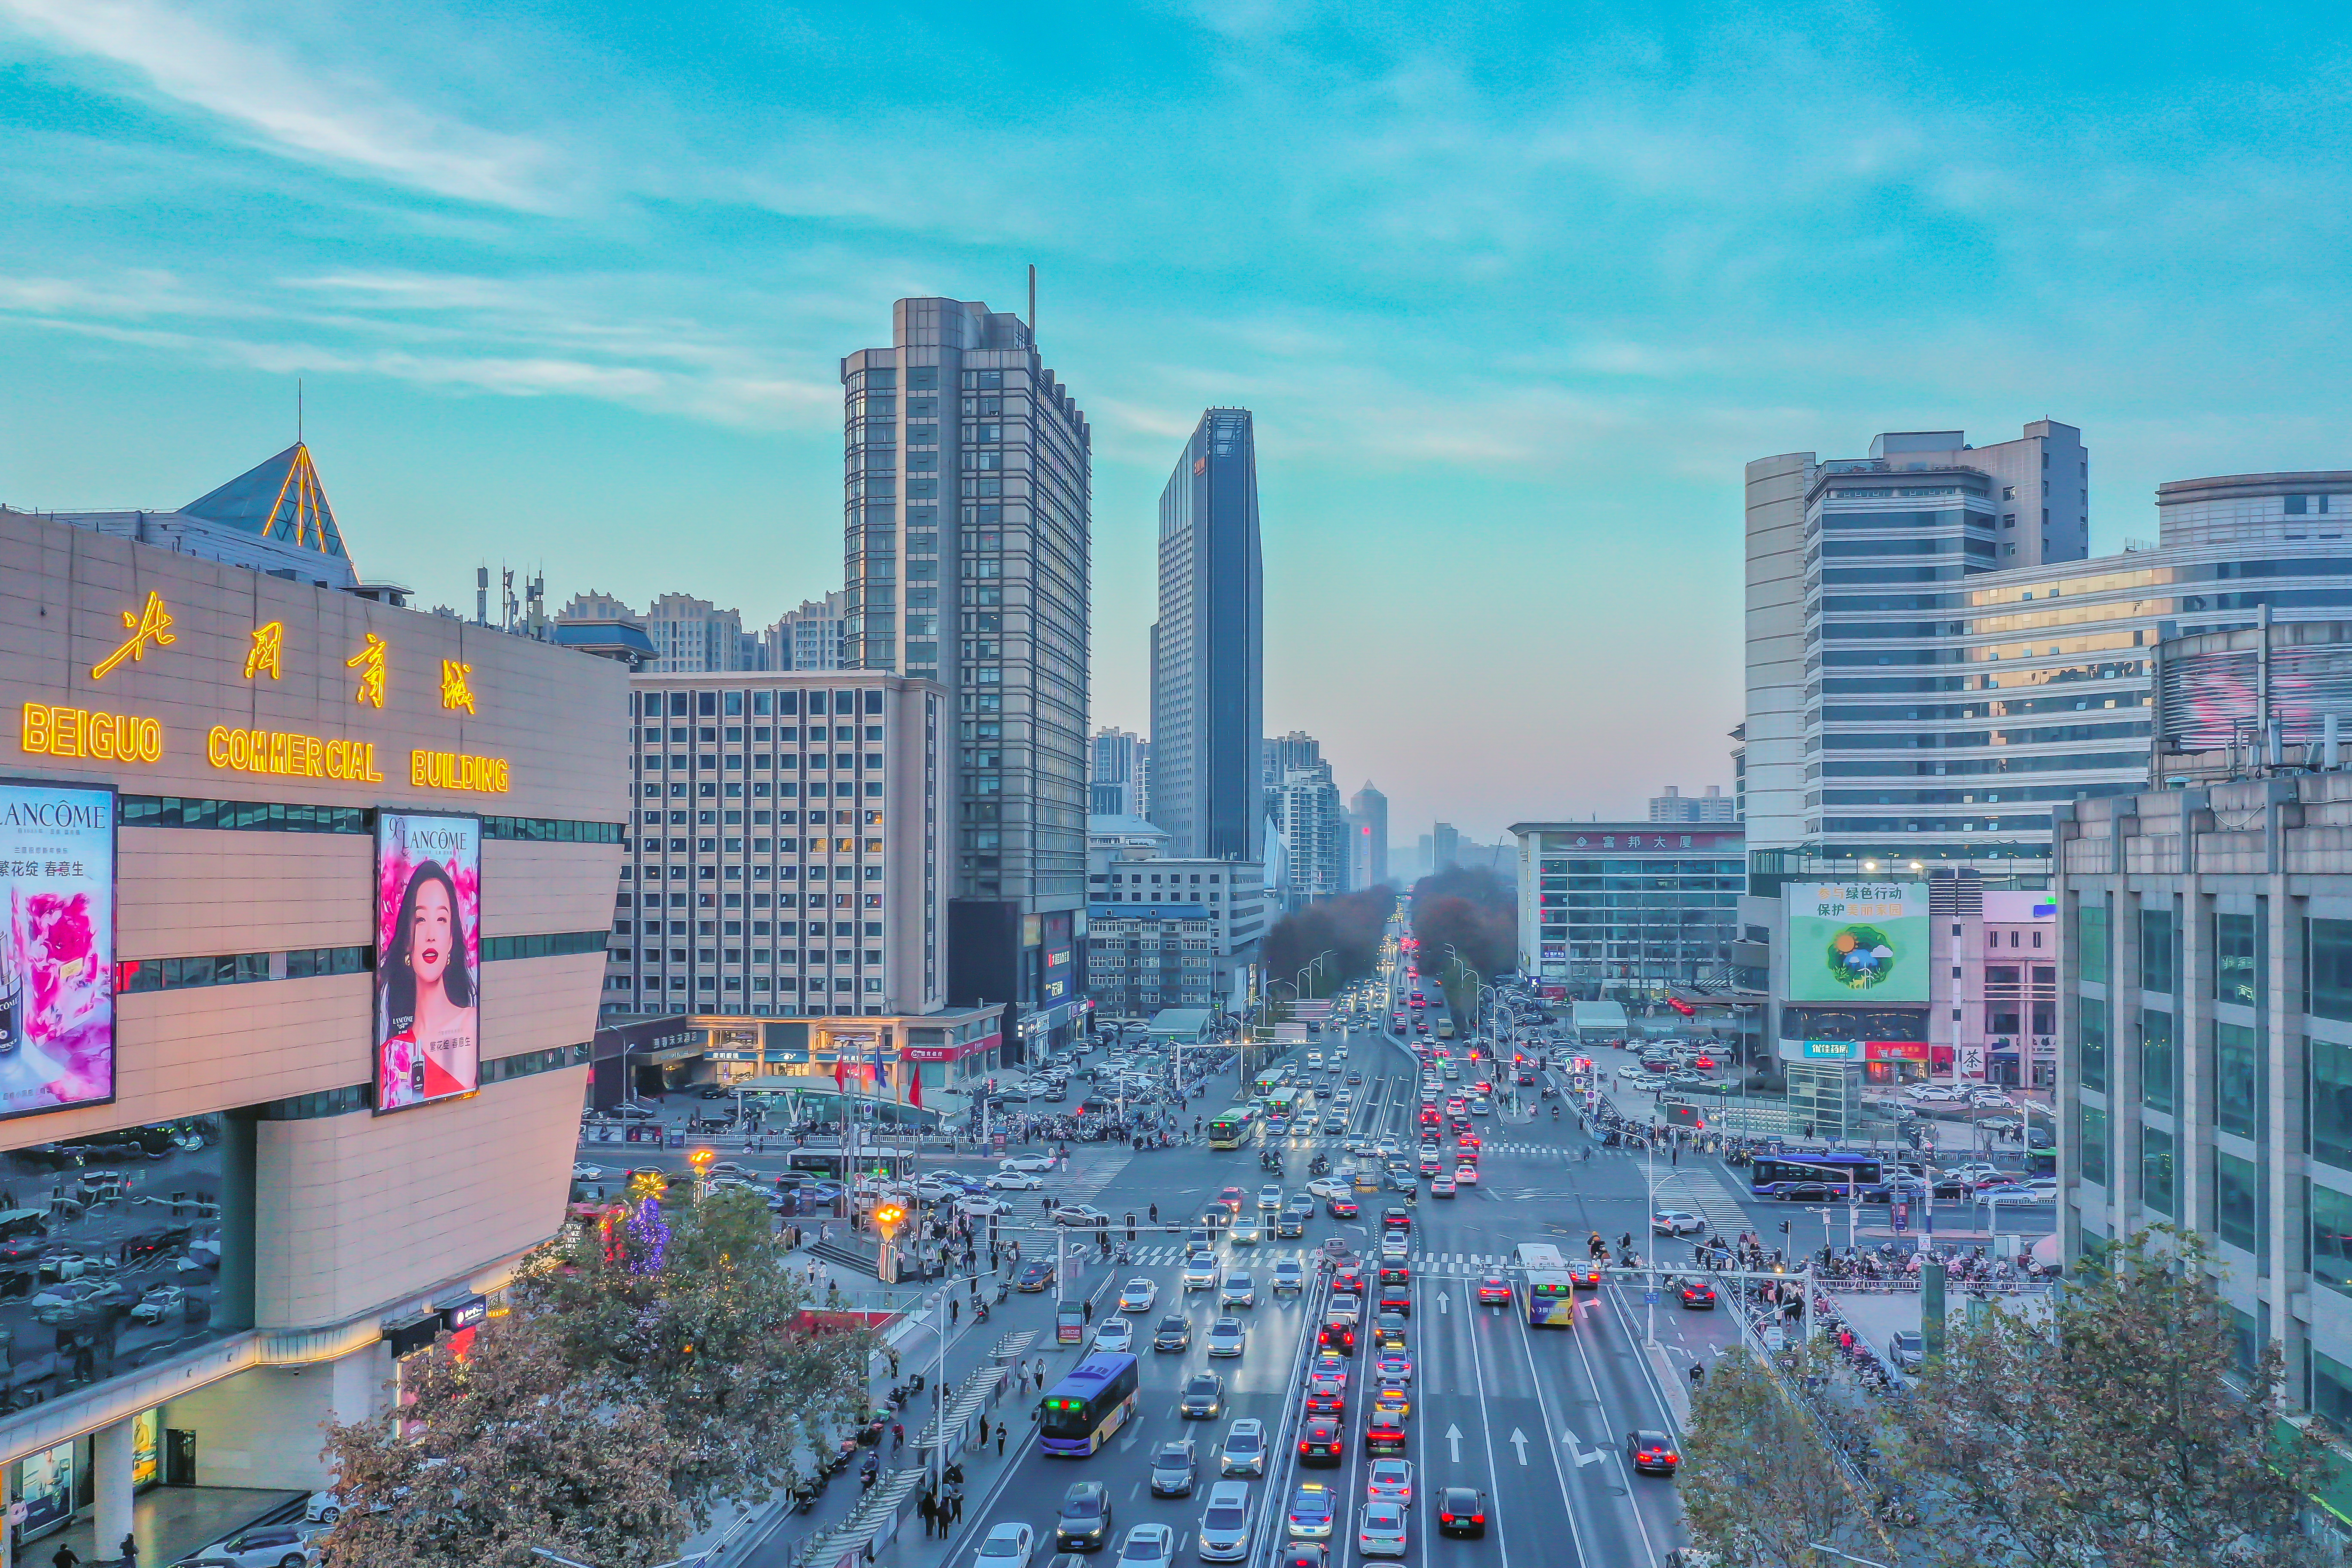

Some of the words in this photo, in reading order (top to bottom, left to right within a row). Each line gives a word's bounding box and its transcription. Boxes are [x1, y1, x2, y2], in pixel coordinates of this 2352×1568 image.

[21, 702, 162, 763] BEIGUO
[208, 725, 383, 782] COMMERCIAL
[410, 749, 509, 793] BUILDING
[0, 799, 106, 829] ANCÔME
[401, 828, 467, 851] LANCÔME
[1602, 835, 1692, 849] 富邦大厦
[44, 860, 84, 877] 春意生
[1817, 886, 1902, 900] 参与绿色行动
[1817, 903, 1902, 916] 保护美丽家园
[1812, 1044, 1848, 1054] 优佳药房
[1963, 1049, 1983, 1069] 茶
